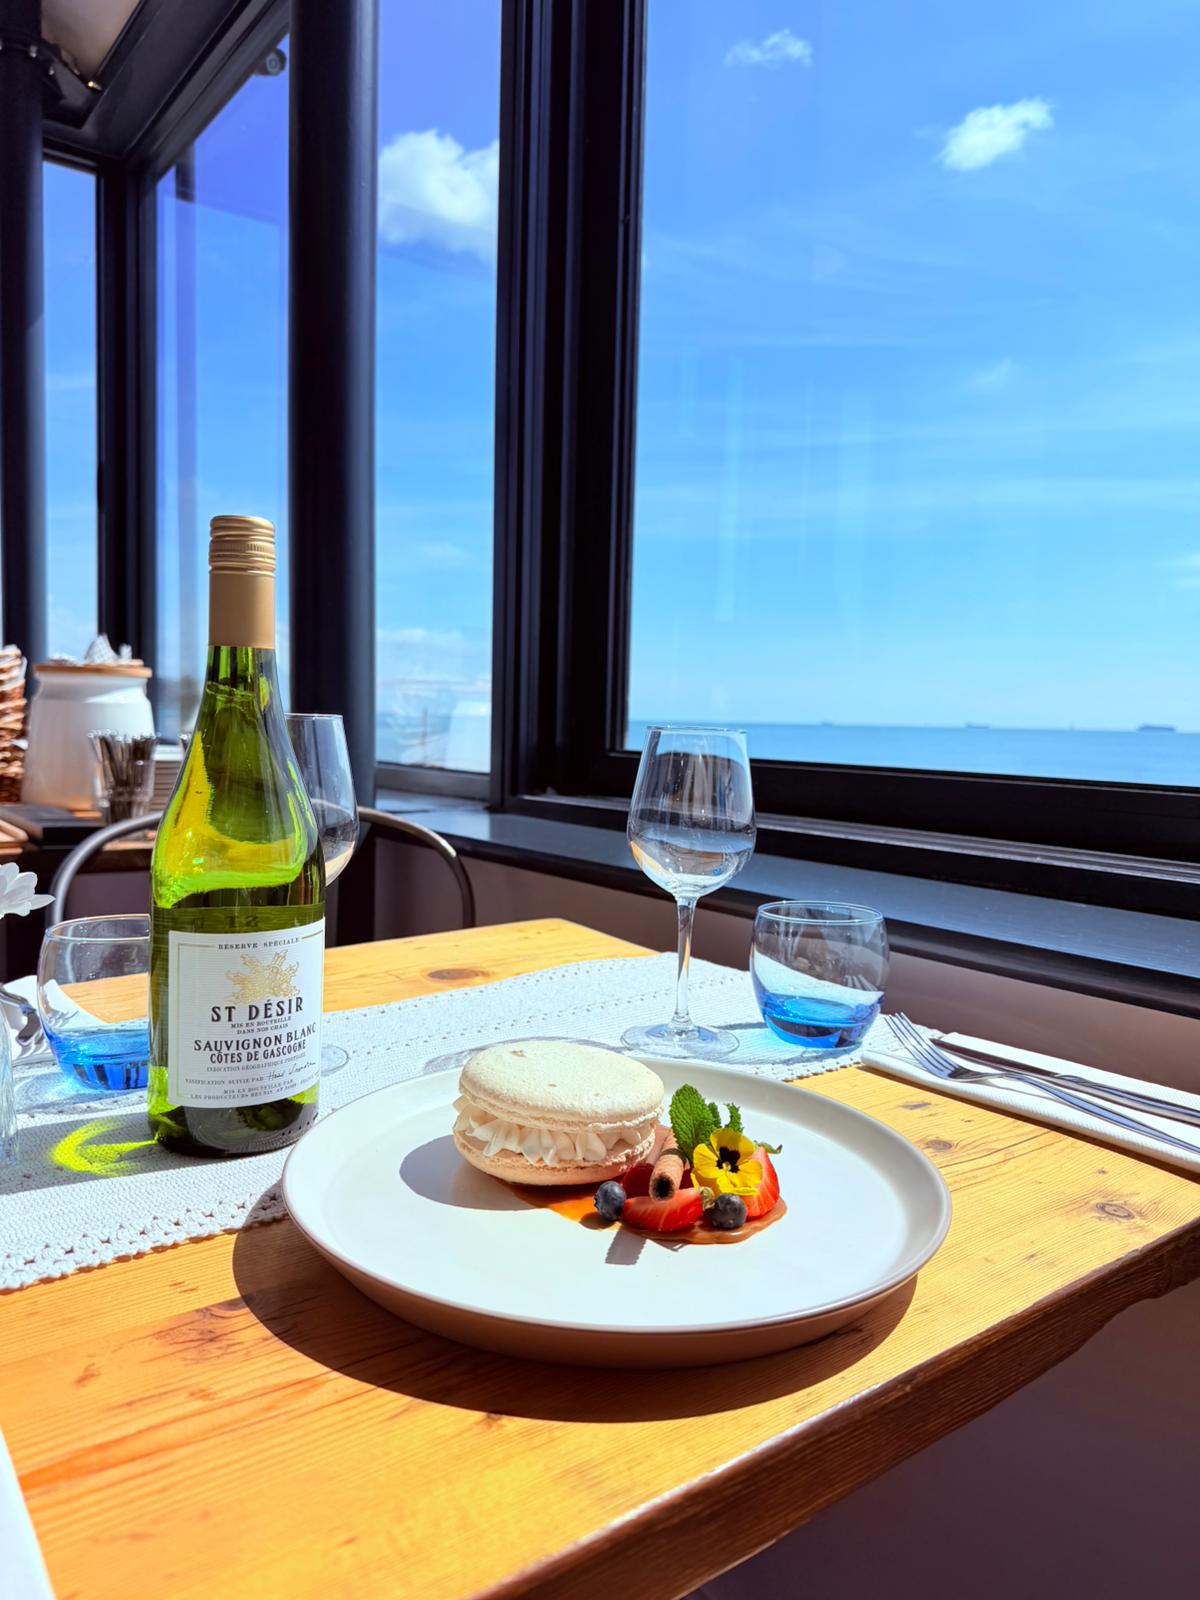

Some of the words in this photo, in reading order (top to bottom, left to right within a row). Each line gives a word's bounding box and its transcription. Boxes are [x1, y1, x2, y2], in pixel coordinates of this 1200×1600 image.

[210, 1005, 236, 1022] ST
[248, 996, 304, 1021] DÉSIR
[194, 1033, 282, 1052] SAUVIGNON
[286, 1022, 317, 1041] BLANC
[210, 1049, 242, 1064] CÔTES
[246, 1050, 259, 1062] DE
[262, 1039, 306, 1060] GASCOGNE
